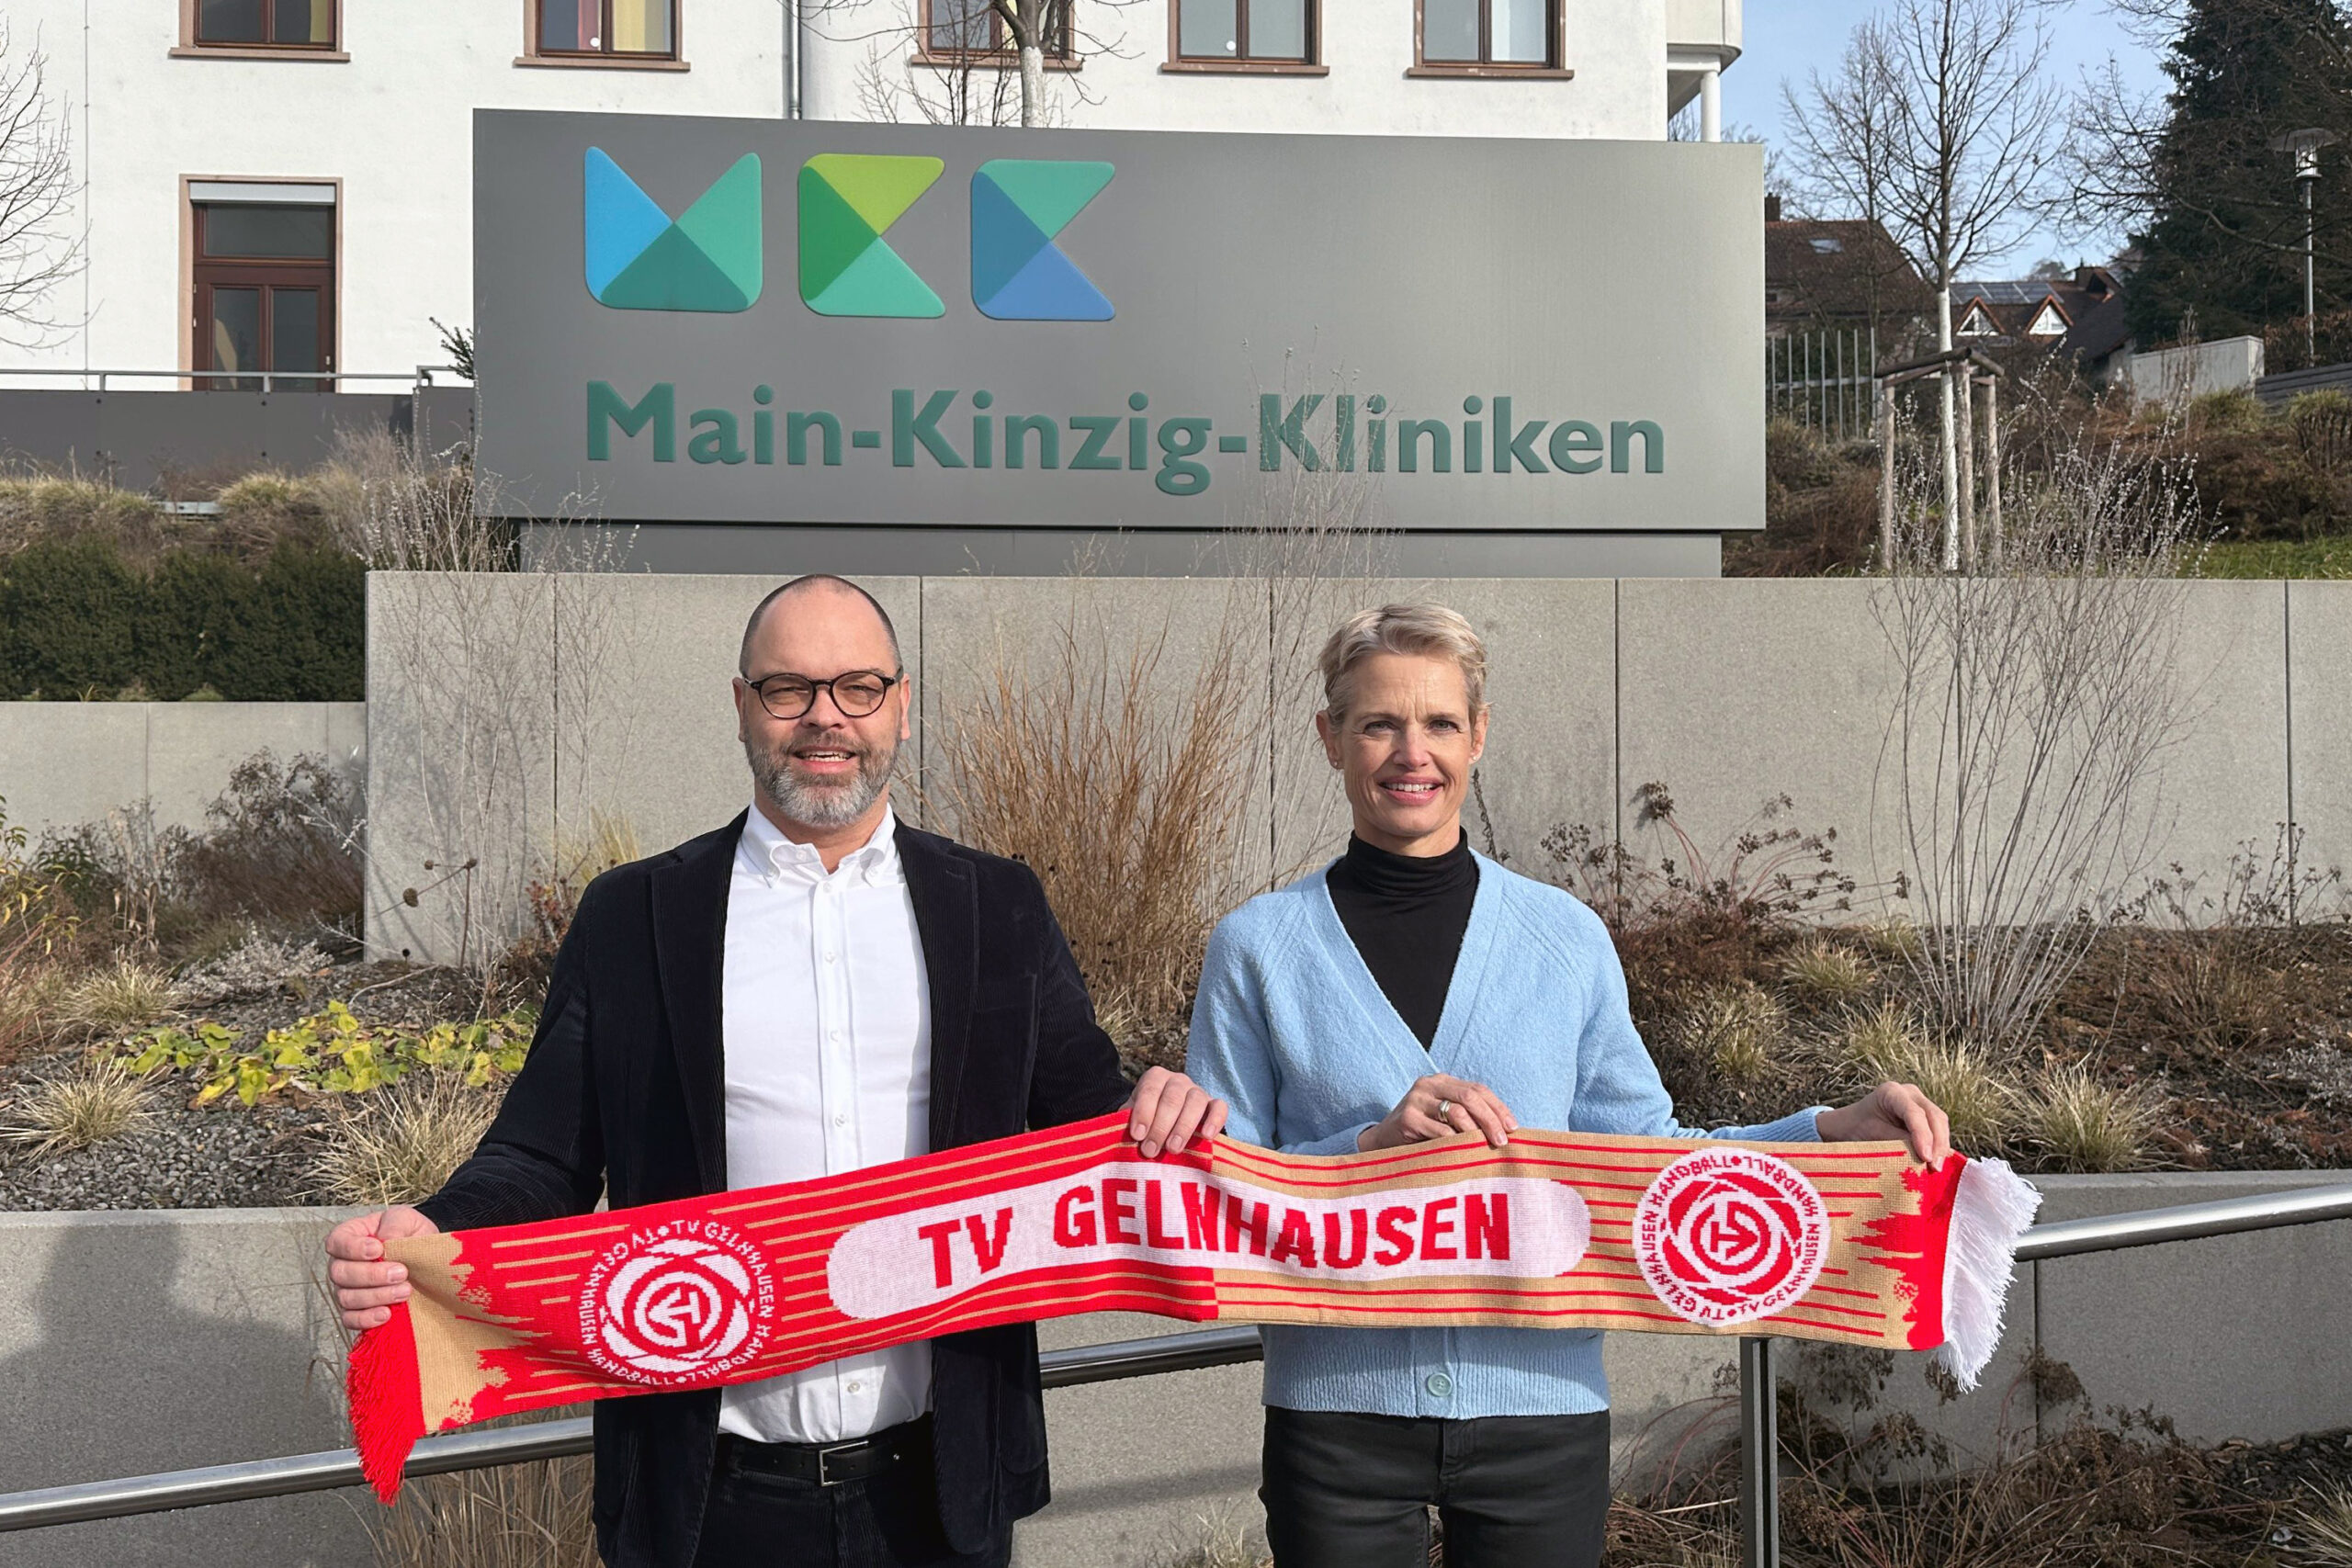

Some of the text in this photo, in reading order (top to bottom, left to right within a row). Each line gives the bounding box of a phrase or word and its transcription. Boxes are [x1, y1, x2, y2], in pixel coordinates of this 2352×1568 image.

[587, 379, 1665, 496] Main-Kinzig-Kliniken
[670, 1219, 701, 1235] TV
[704, 1222, 775, 1319] GELNHAUSEN
[919, 1178, 1511, 1289] TV GELNHAUSEN
